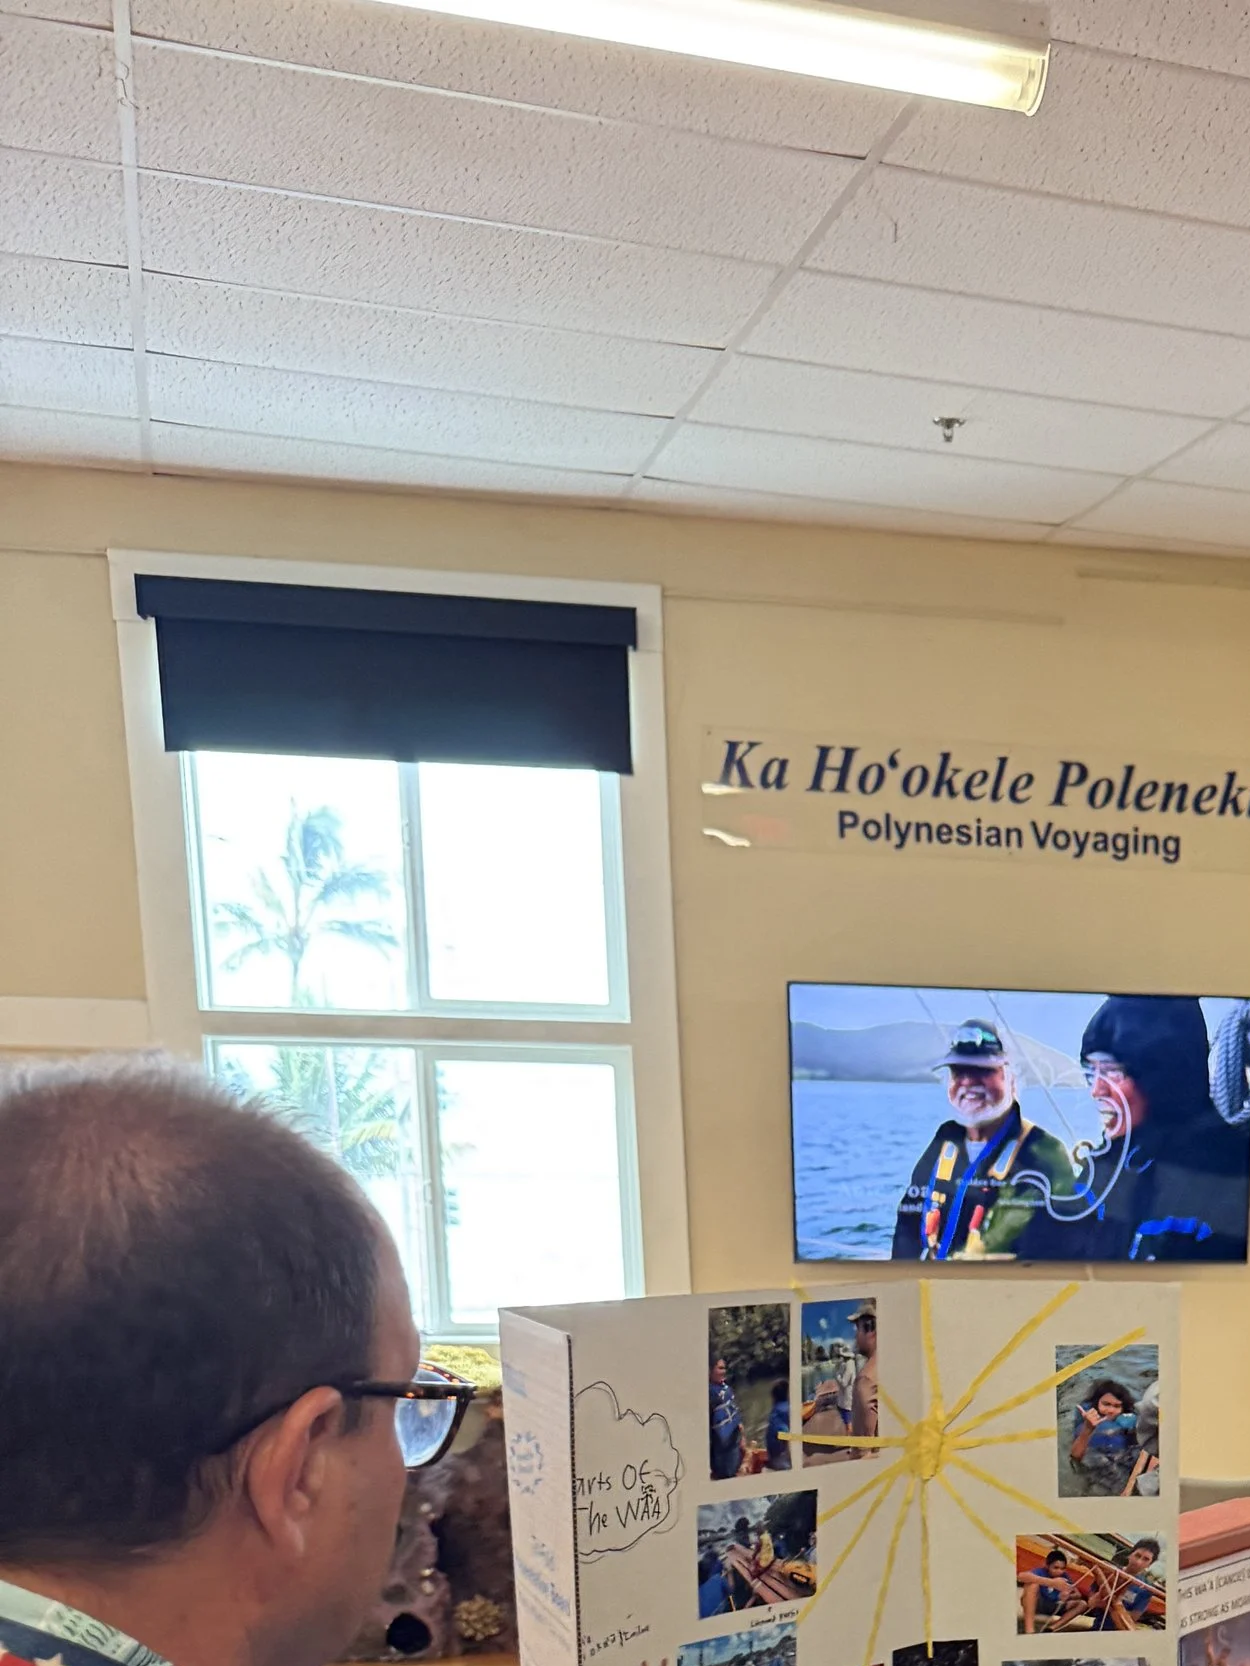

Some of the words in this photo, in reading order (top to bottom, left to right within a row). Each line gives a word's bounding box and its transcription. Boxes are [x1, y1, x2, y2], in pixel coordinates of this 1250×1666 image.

[718, 740, 790, 791] Ka
[838, 811, 1023, 850] Polynesian
[1031, 821, 1182, 863] Voyaging
